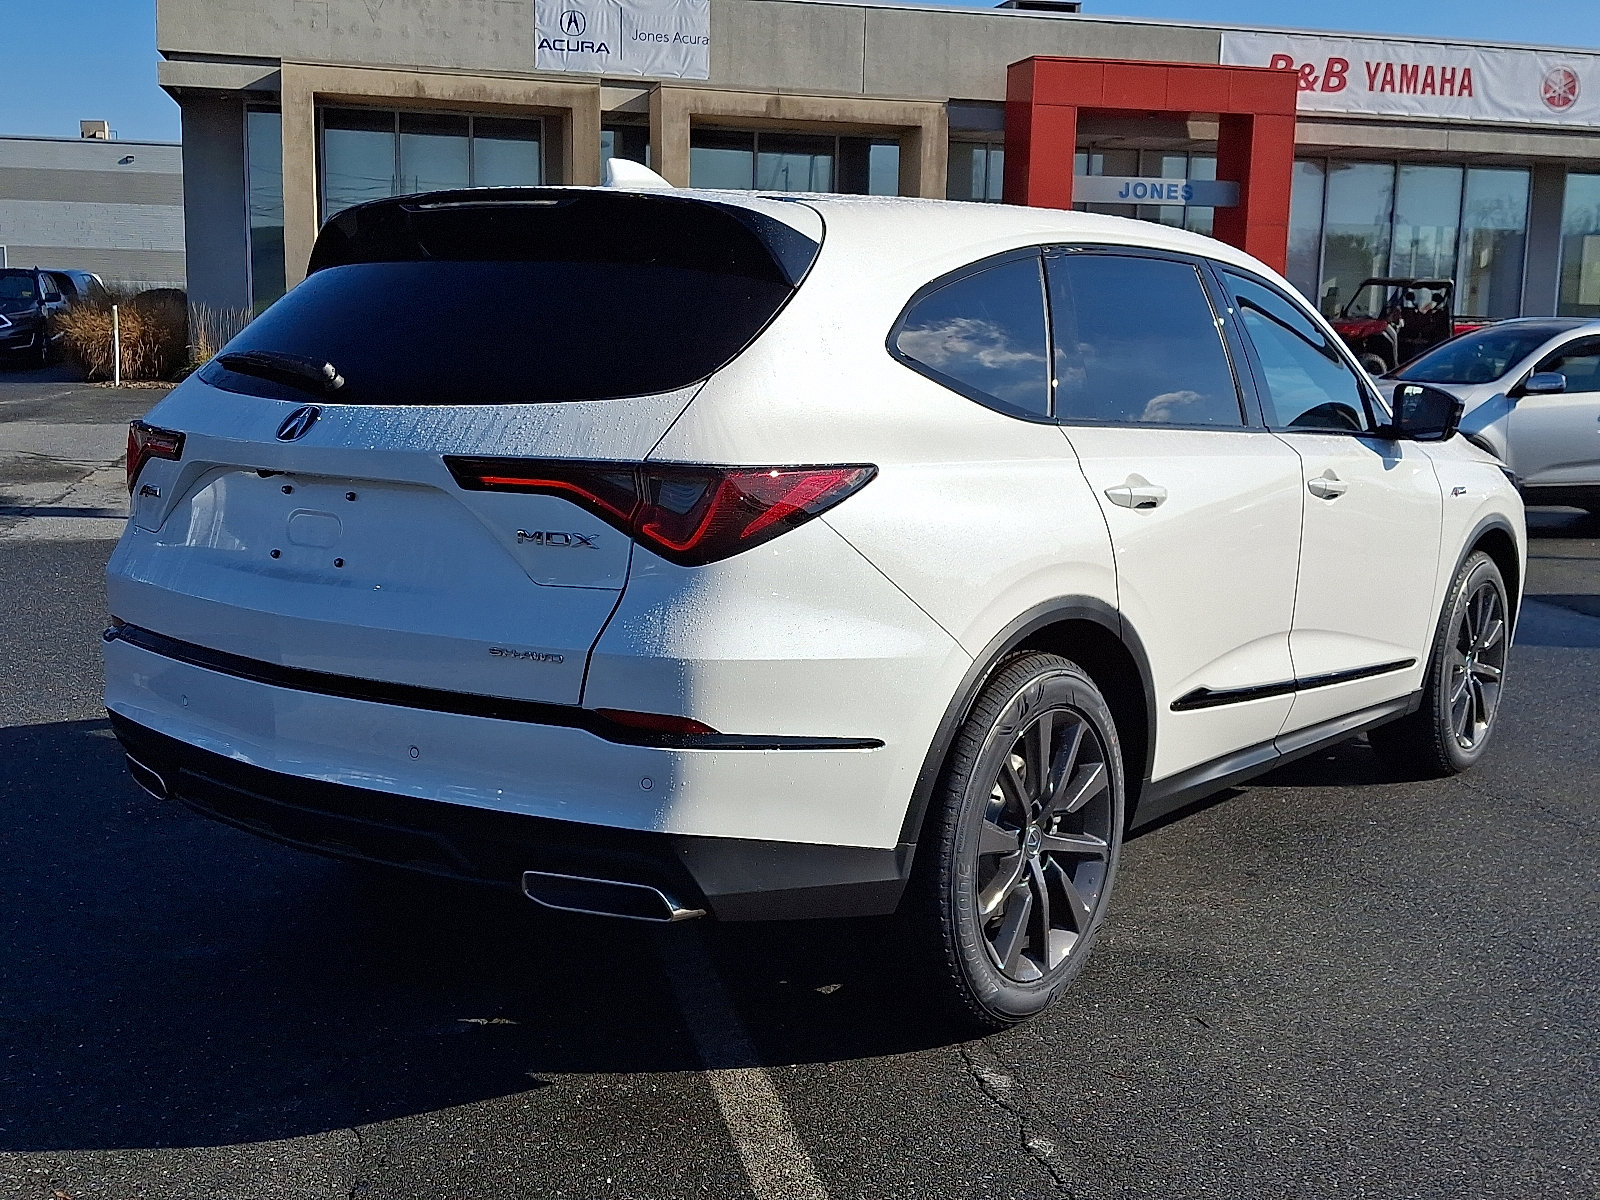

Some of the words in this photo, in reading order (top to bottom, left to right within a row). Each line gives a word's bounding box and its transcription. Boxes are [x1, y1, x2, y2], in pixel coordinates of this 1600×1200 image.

[537, 38, 611, 55] ACURA
[631, 29, 670, 44] Jones
[672, 31, 710, 46] Acura
[1364, 61, 1473, 97] YAMAHA
[1118, 181, 1194, 201] JONES
[516, 528, 601, 550] MDX
